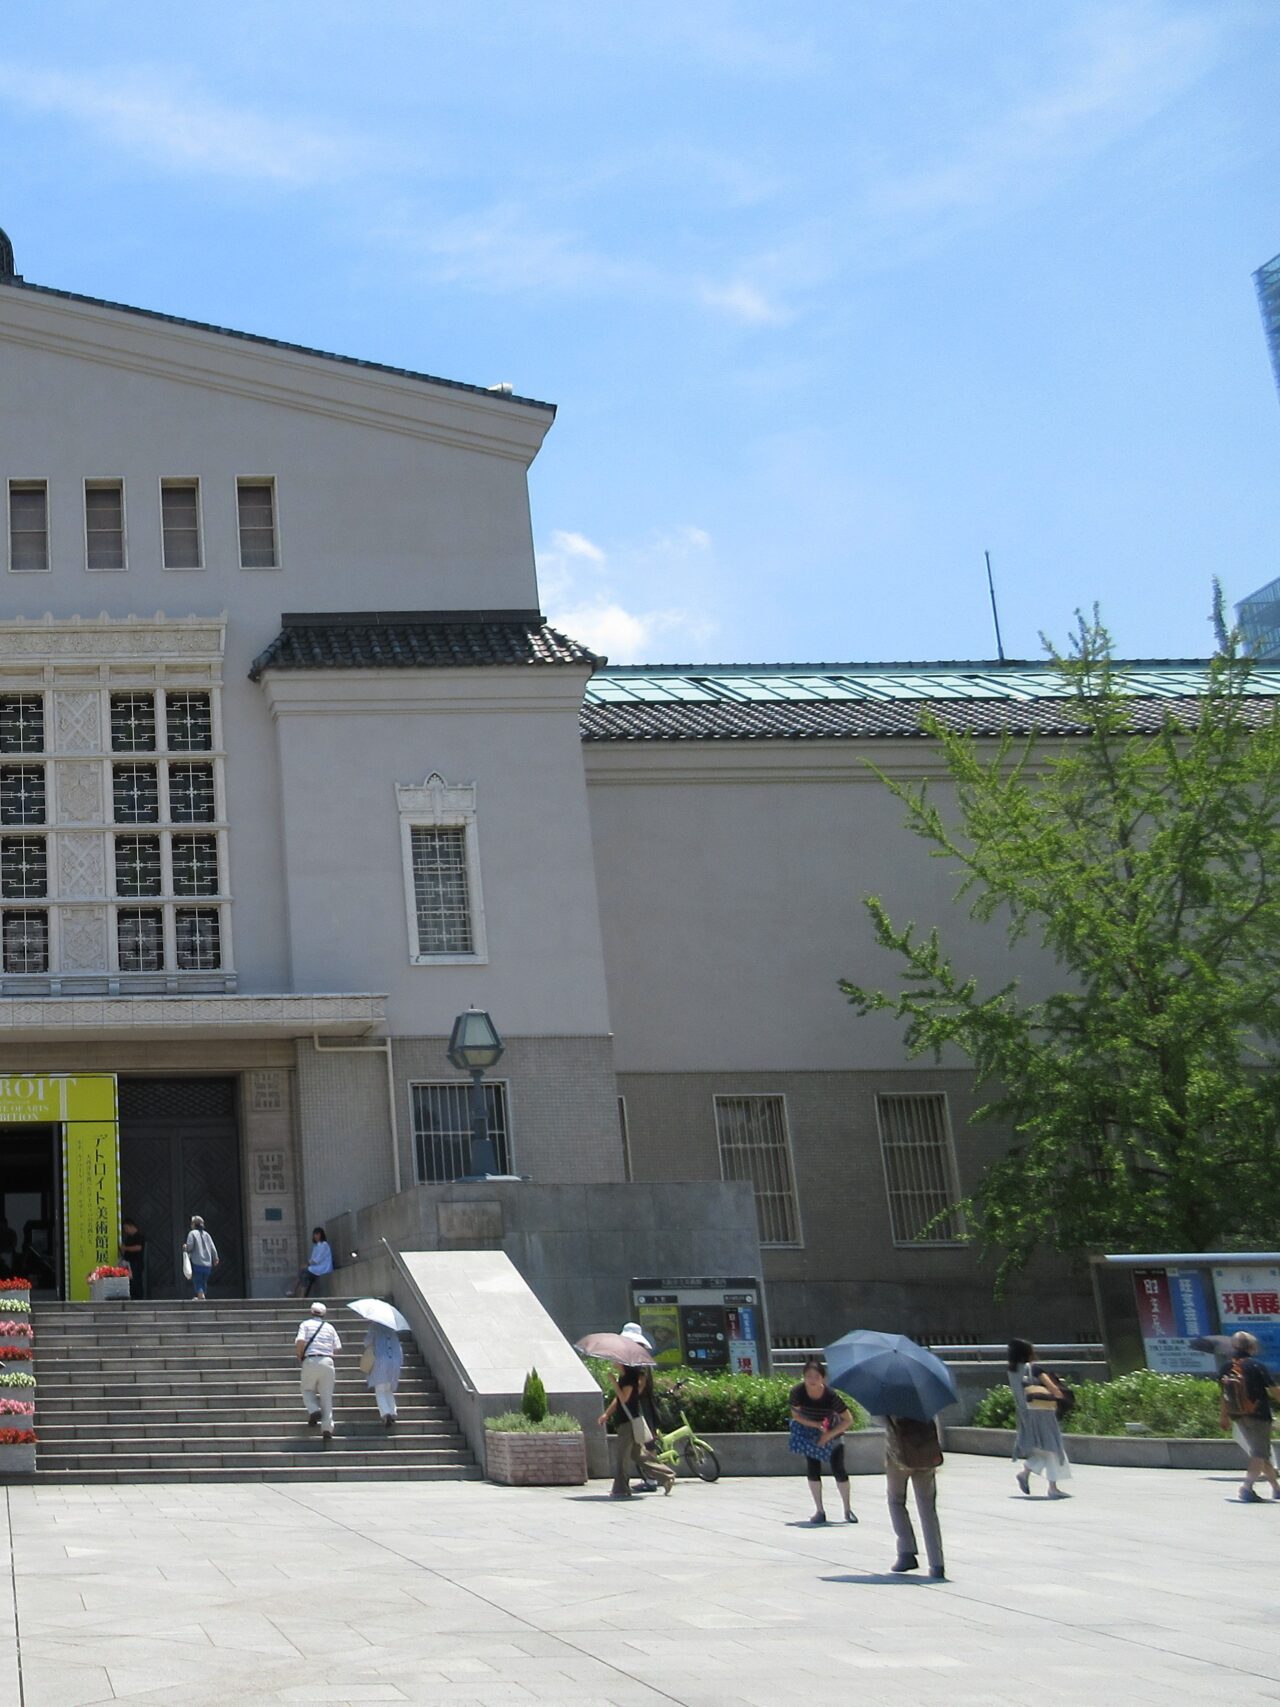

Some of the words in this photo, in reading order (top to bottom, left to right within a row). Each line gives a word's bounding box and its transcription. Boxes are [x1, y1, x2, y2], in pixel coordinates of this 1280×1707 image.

[27, 1104, 49, 1112] ARTS
[94, 1134, 109, 1263] デトロイト美術館展
